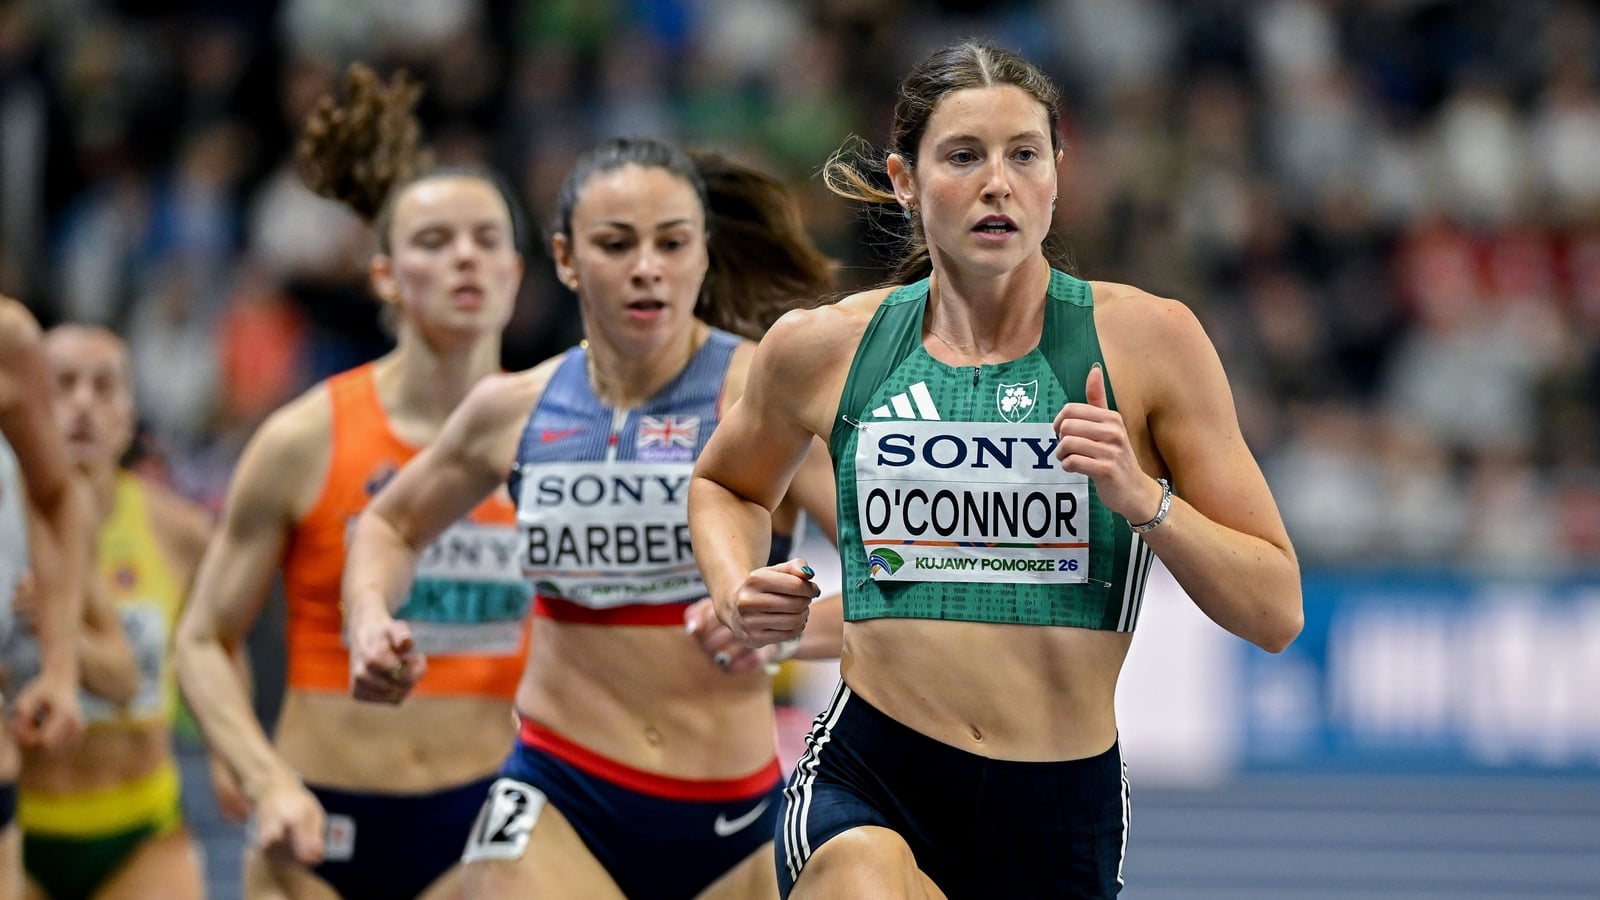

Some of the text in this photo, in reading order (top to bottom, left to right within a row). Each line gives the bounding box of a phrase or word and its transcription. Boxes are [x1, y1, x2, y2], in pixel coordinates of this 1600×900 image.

[877, 433, 1058, 470] SONY
[537, 474, 689, 507] SONY
[865, 487, 1078, 539] O'CONNOR
[527, 525, 694, 567] BARBER
[915, 557, 1079, 572] KUJAWY POMORZE 26
